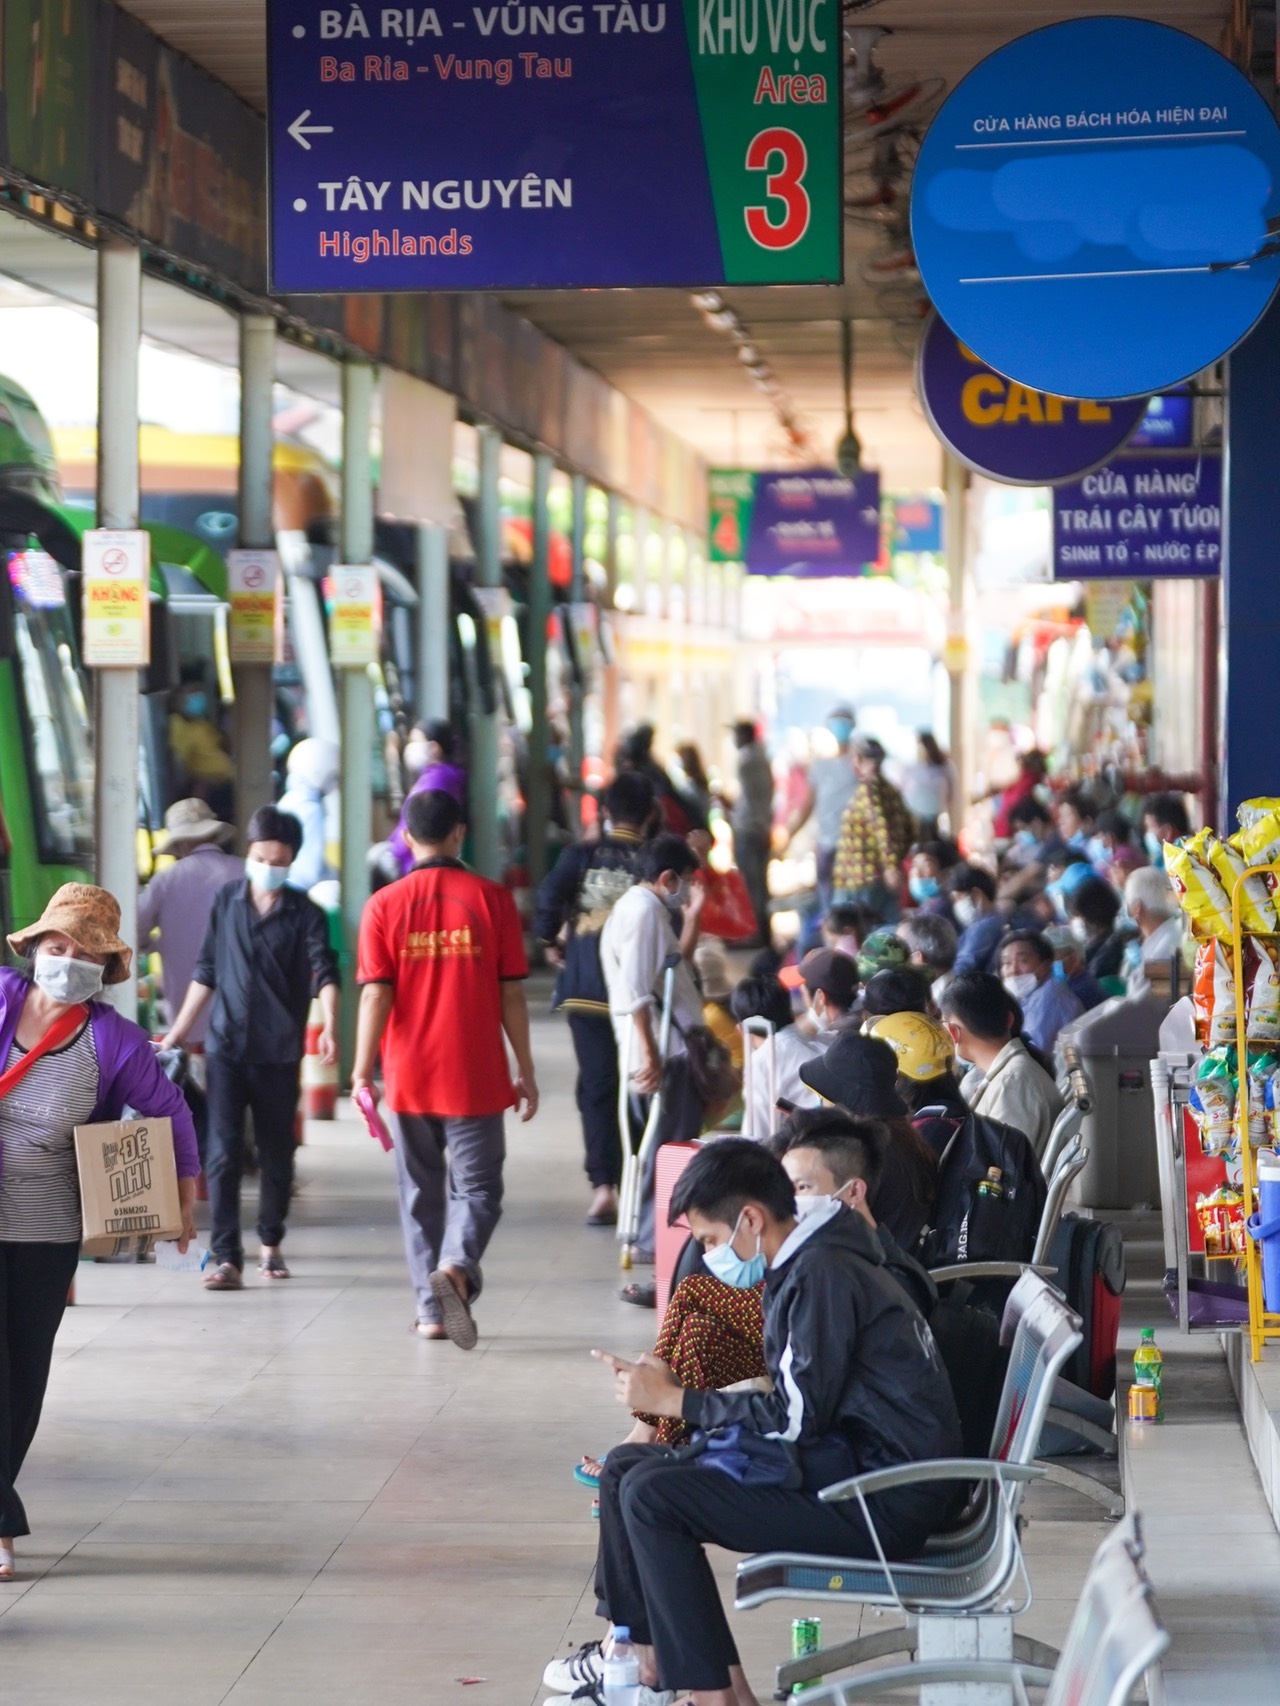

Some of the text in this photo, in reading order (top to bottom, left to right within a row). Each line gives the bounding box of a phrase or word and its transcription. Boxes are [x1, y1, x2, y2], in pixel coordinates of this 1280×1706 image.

[320, 3, 371, 39] BÀ
[381, 6, 443, 45] RỊA
[473, 0, 585, 36] VŨNG
[592, 0, 667, 33] TÀU
[697, 0, 760, 54] KHU
[321, 55, 355, 82] Ba
[363, 54, 410, 81] Ria
[434, 53, 513, 86] Vung
[519, 51, 573, 79] Tau
[753, 66, 827, 104] Area
[973, 105, 1229, 133] CỬA HÀNG BÁCH HÓA HIỆN ĐẠI
[318, 172, 574, 212] TÂY NGUYÊN
[743, 126, 812, 252] 3
[320, 228, 473, 263] Highlands
[1082, 467, 1197, 496] CỬA HÀNG
[1059, 504, 1112, 531] TRÁI
[1118, 502, 1163, 530] CÂY
[1060, 544, 1100, 562] SINH
[1105, 538, 1130, 561] TỐ
[1144, 541, 1192, 561] NƯỚC
[1196, 541, 1220, 560] ÉP
[114, 1205, 149, 1216] 03NM202
